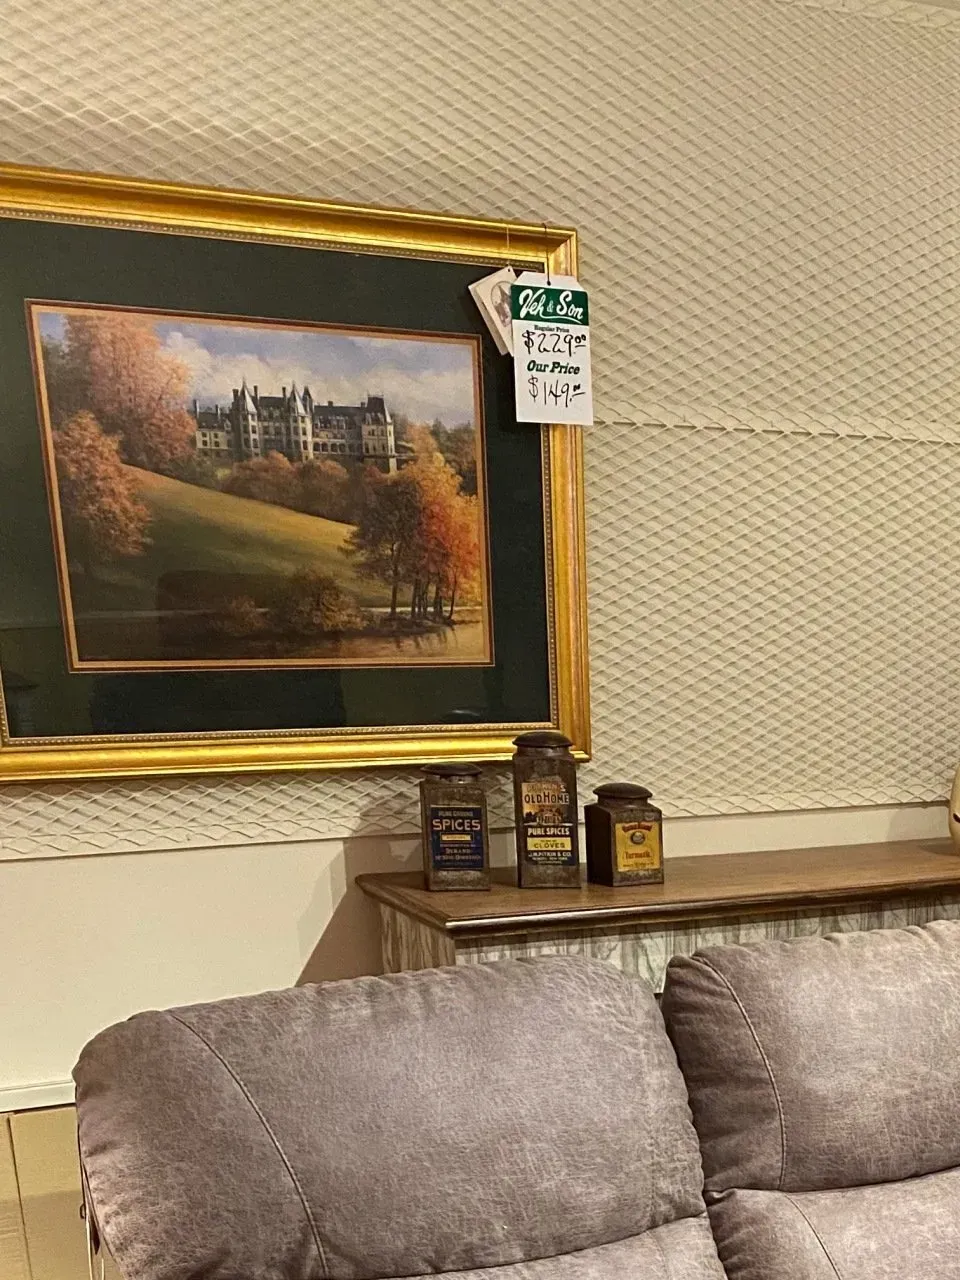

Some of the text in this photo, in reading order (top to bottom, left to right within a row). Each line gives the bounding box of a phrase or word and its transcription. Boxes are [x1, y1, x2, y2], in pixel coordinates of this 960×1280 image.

[519, 288, 584, 320] Veh & Son
[534, 324, 555, 332] Regular
[527, 359, 581, 375] Our Price
[432, 818, 481, 831] SPICES
[545, 826, 570, 836] SPICES
